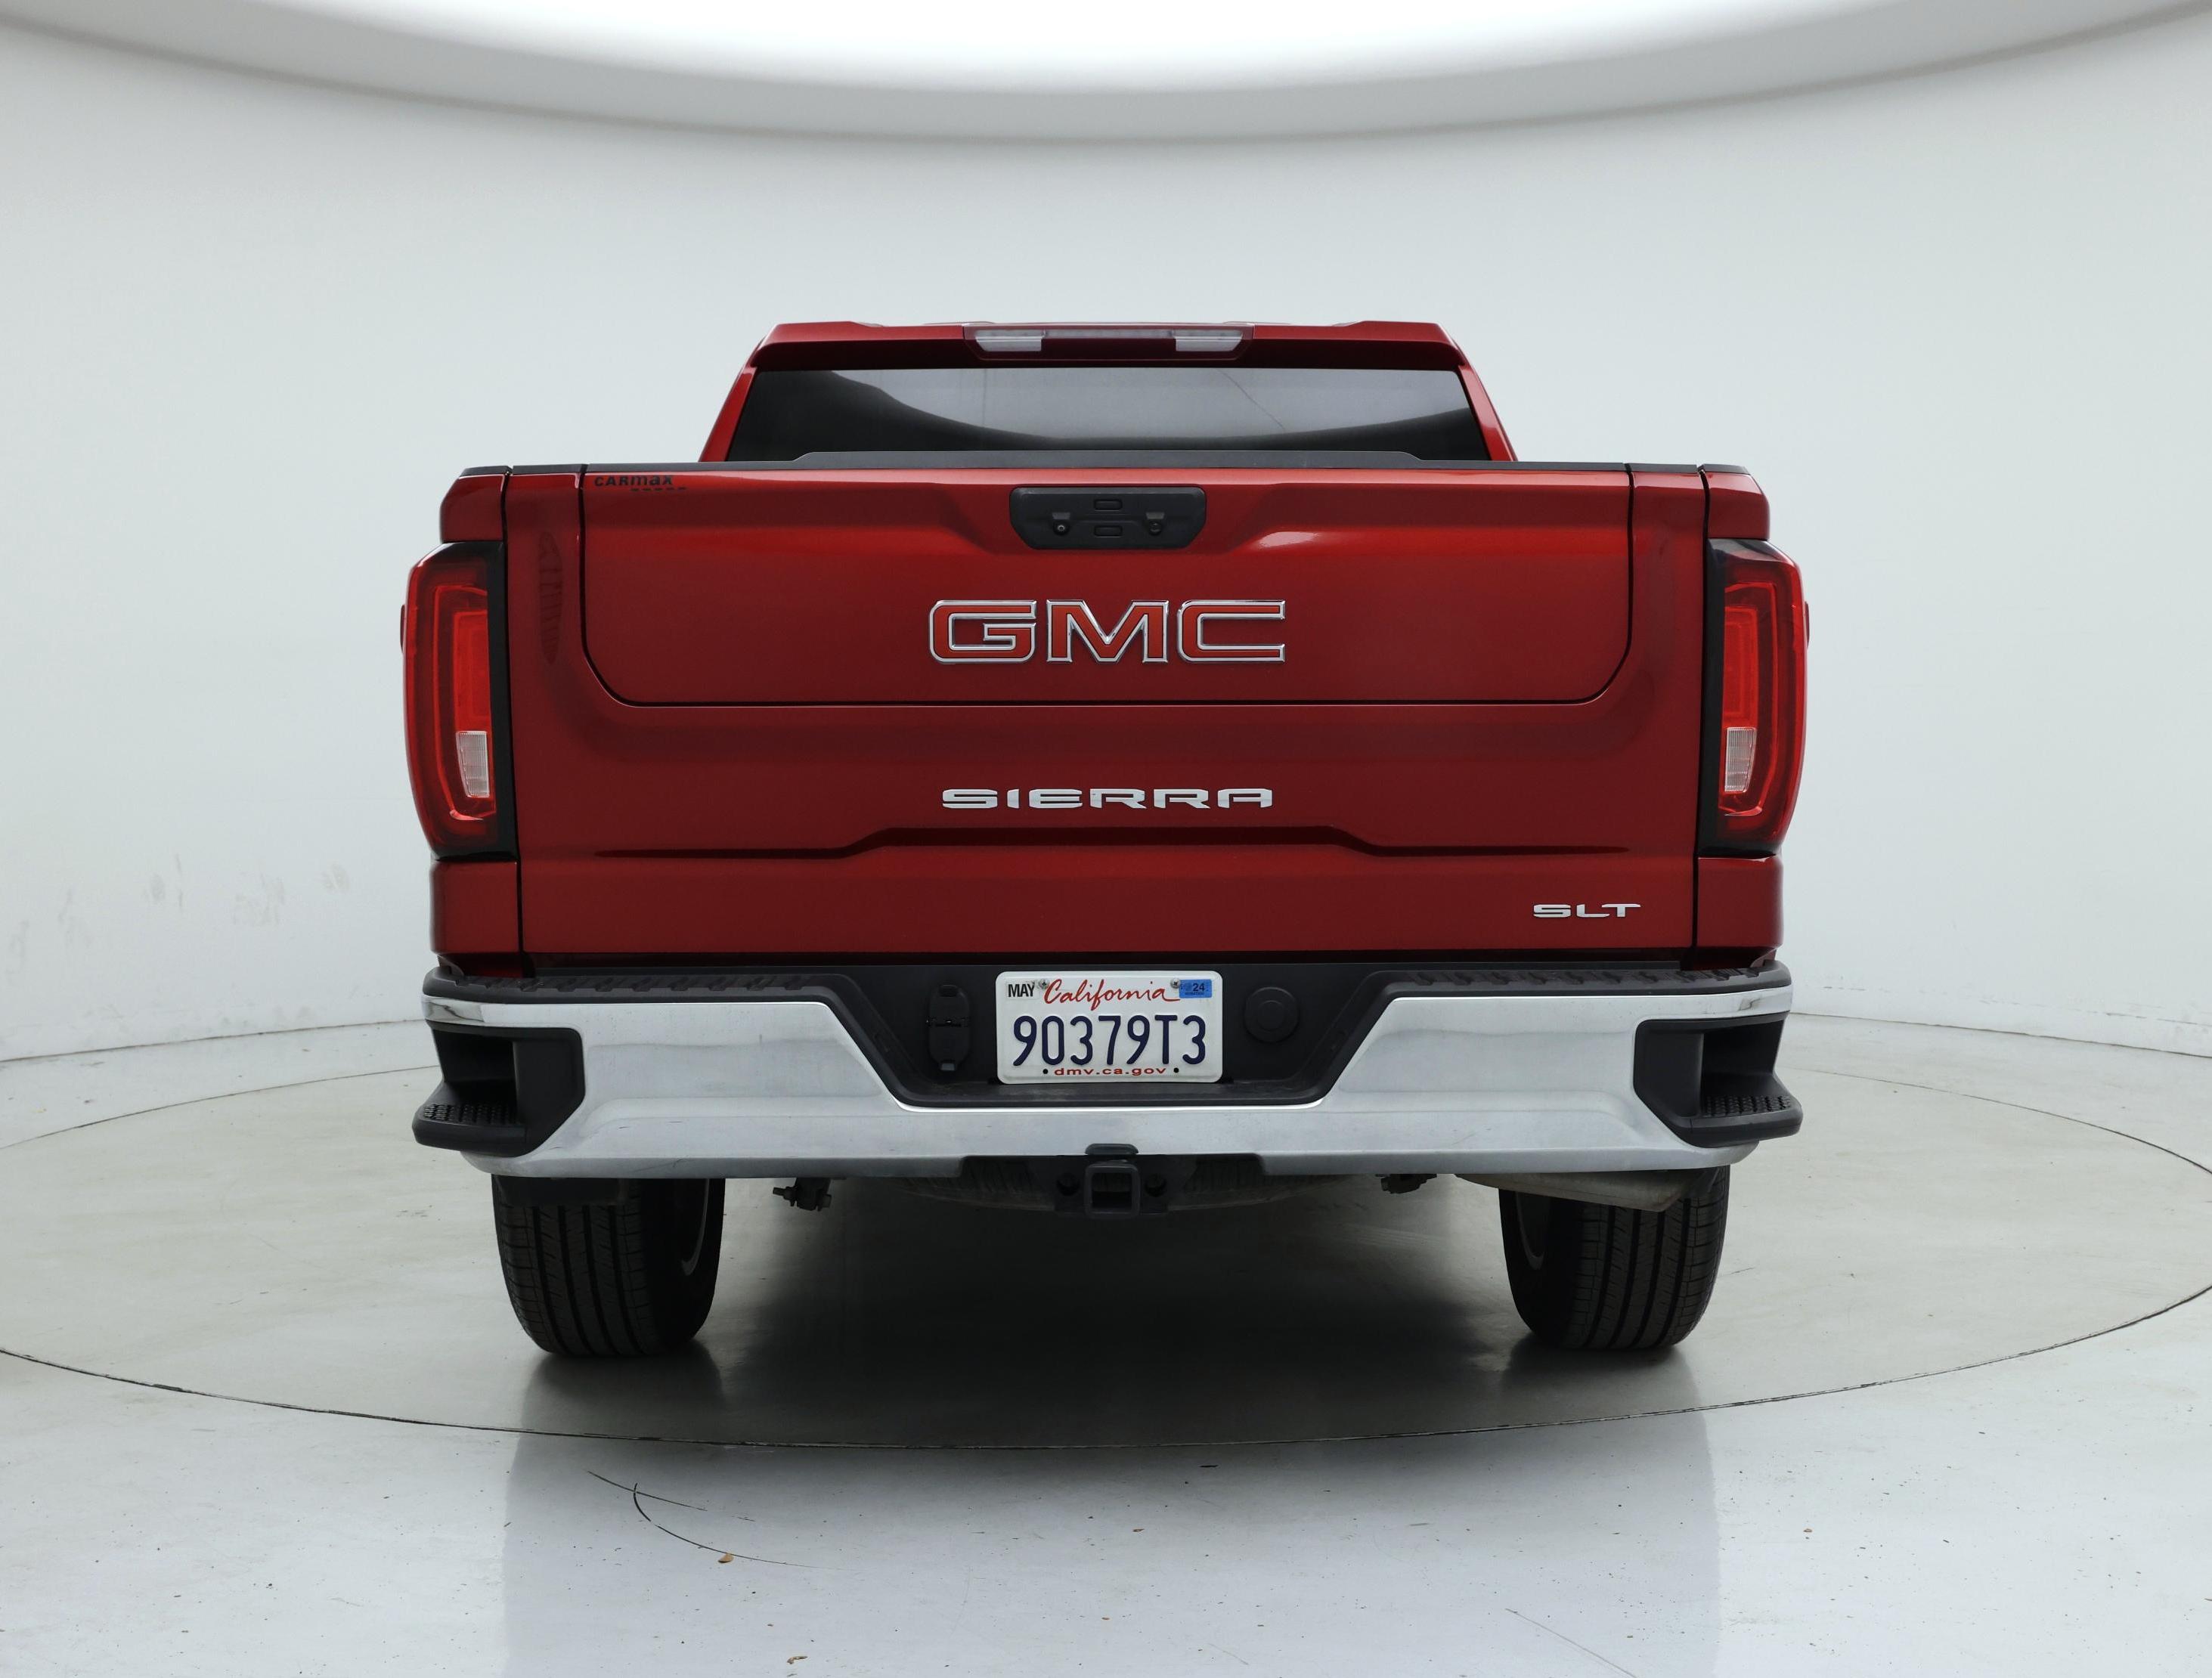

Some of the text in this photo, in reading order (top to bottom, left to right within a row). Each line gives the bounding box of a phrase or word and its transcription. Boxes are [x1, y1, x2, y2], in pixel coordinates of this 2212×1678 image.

[929, 599, 1286, 664] GMC
[942, 788, 1273, 810] SIERRA
[1533, 903, 1641, 918] SLT
[1008, 983, 1035, 997] MAY
[1044, 979, 1181, 1011] California
[1192, 983, 1205, 992] 24
[1013, 1014, 1207, 1067] 90379T3
[1054, 1067, 1166, 1076] dmv.ca.gov
